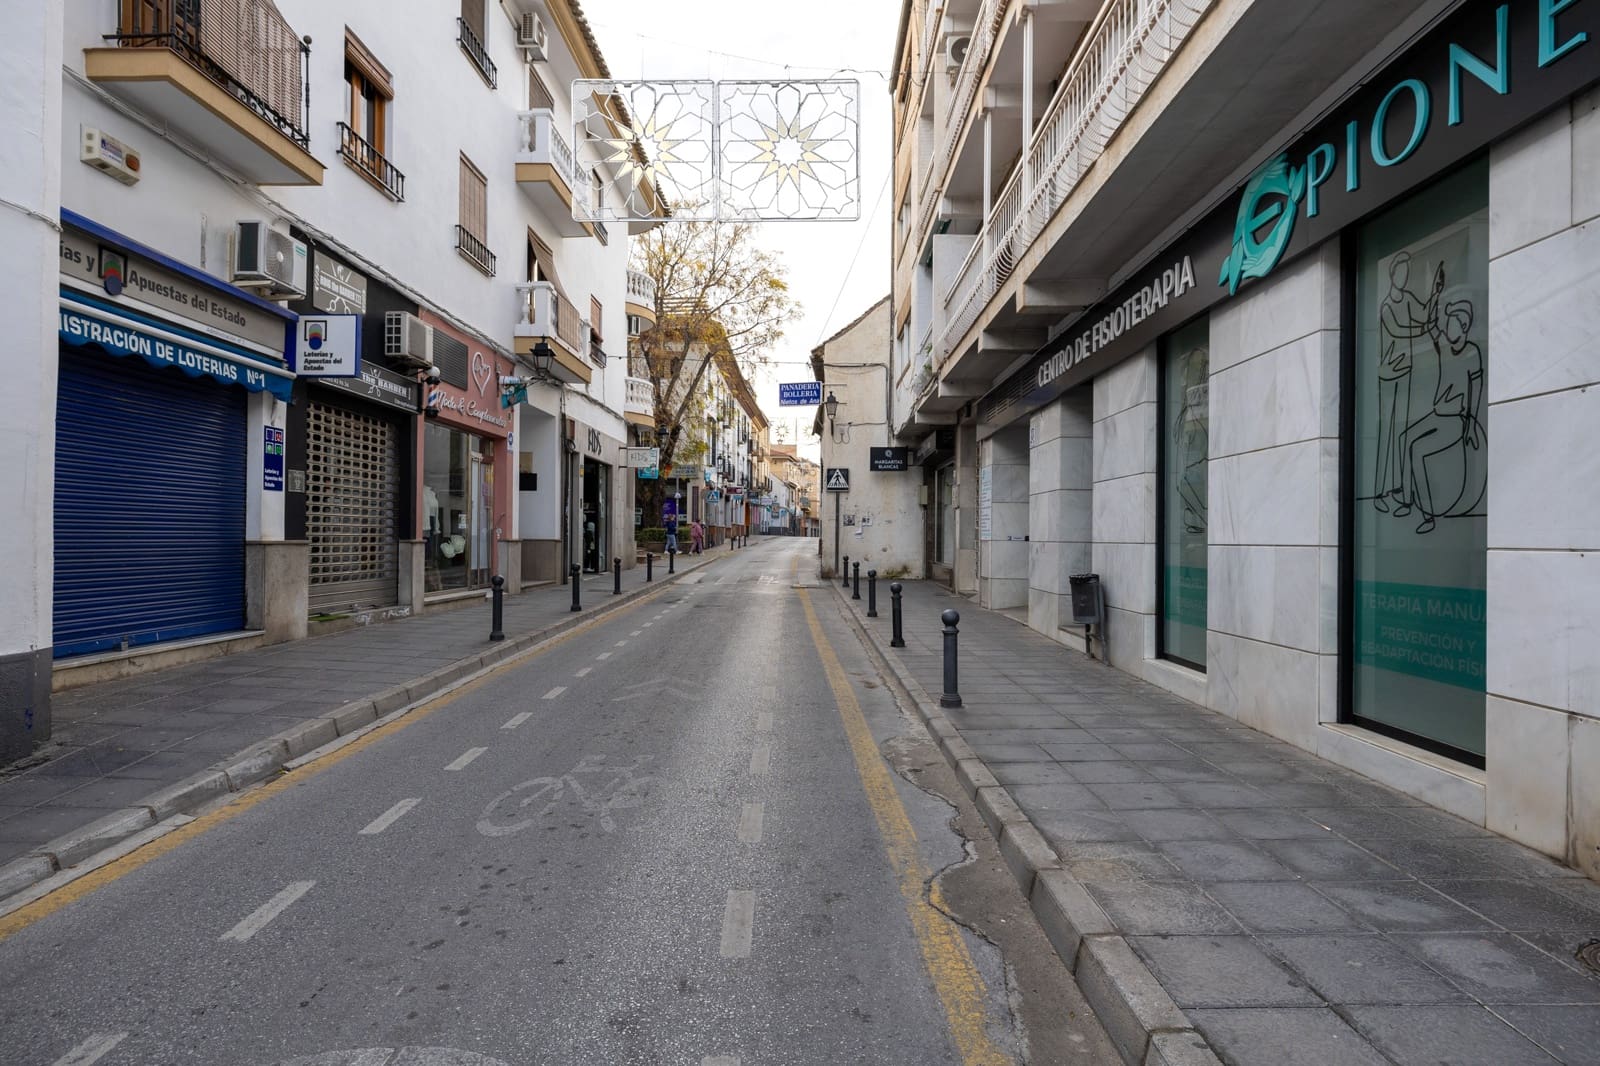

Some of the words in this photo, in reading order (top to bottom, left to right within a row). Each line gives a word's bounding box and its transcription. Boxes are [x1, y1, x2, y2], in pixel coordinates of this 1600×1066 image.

[86, 255, 96, 273] y
[128, 270, 188, 305] Apuestas
[191, 294, 208, 313] del
[211, 302, 246, 327] Estado
[1038, 345, 1073, 387] CENTRO
[1074, 330, 1091, 365] DE
[1092, 255, 1196, 352] FISIOTERAPIA
[59, 313, 152, 356] ISTRACIÓN
[155, 341, 174, 362] DE
[178, 348, 238, 381] LOTERIAS
[781, 383, 820, 392] PANADERIA
[783, 390, 818, 398] BOLLERIA
[1361, 592, 1423, 615] TERAPIA
[1427, 598, 1487, 622] MANU
[1381, 625, 1464, 653] PREVENCIÓN
[1467, 639, 1477, 653] Y
